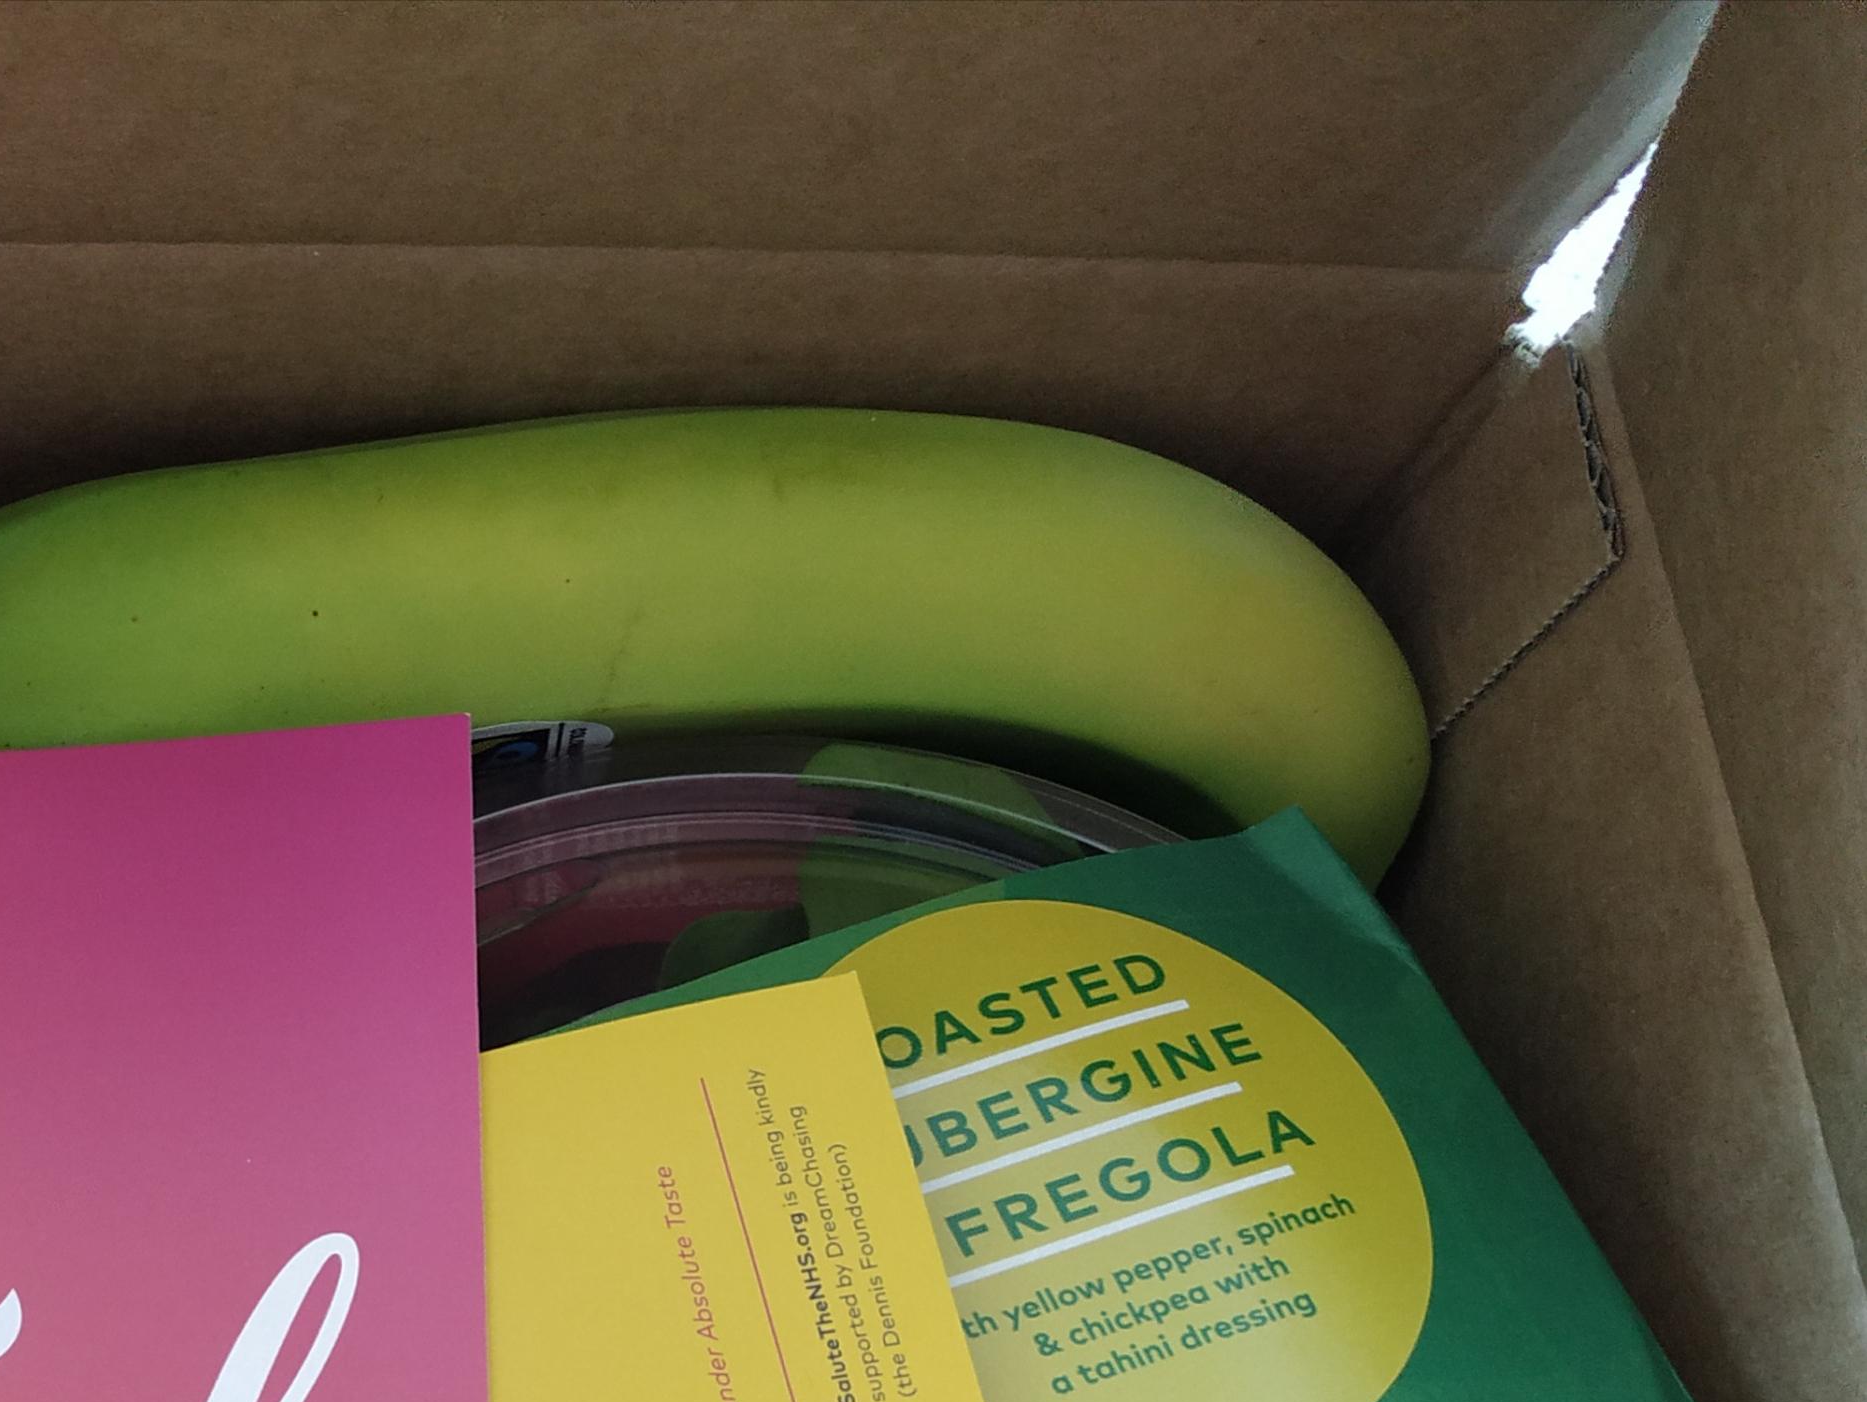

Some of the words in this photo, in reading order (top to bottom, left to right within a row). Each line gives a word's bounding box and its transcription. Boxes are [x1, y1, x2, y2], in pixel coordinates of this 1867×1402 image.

[745, 1068, 775, 1126] kindly
[656, 1165, 686, 1229] Taste
[765, 1129, 793, 1186] being
[781, 1189, 799, 1208] is
[788, 1105, 844, 1259] DreamChasing
[826, 1143, 878, 1270] Foundation)
[945, 1110, 1316, 1258] FREGOLA
[676, 1235, 719, 1341] Absolute
[833, 1263, 854, 1289] by
[866, 1274, 901, 1348] Dennis
[1001, 1276, 1106, 1332] yellow
[1110, 1235, 1234, 1294] pepper,
[1235, 1192, 1356, 1246] spinach
[1031, 1331, 1065, 1357] &
[1067, 1284, 1211, 1346] chickpea
[1212, 1254, 1291, 1296] with
[837, 1292, 886, 1402] supported
[891, 1352, 918, 1397] (the
[1050, 1373, 1075, 1395] a
[1075, 1332, 1175, 1386] tahini
[1178, 1291, 1318, 1350] dressing
